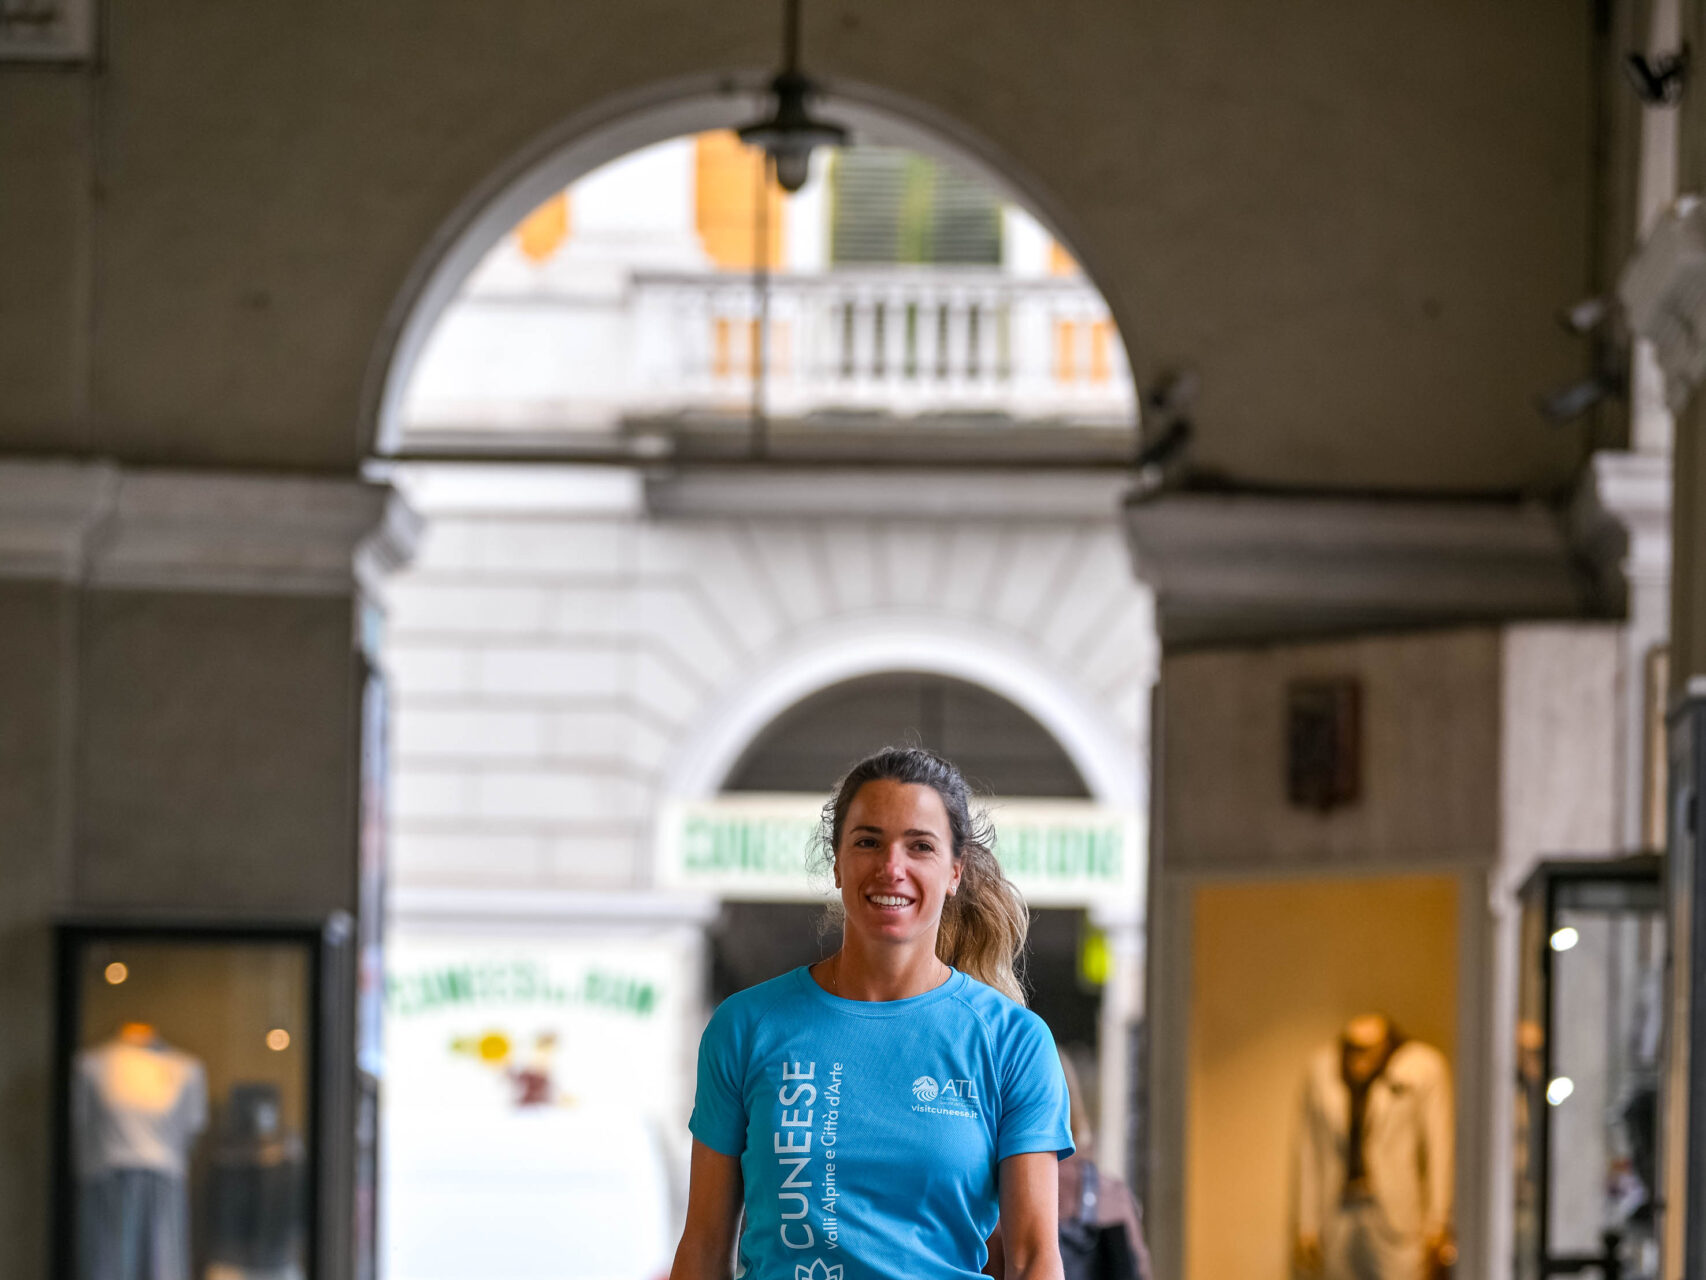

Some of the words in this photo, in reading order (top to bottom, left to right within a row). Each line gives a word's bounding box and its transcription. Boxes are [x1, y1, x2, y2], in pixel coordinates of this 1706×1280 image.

[823, 1062, 844, 1107] d'Arte
[941, 1078, 979, 1099] ATL
[820, 1110, 839, 1147] Città
[911, 1104, 979, 1119] visitcuneese.it
[774, 1061, 817, 1249] CUNEESE
[825, 1149, 836, 1160] e
[821, 1162, 841, 1214] Alpine
[822, 1217, 839, 1250] Valli
